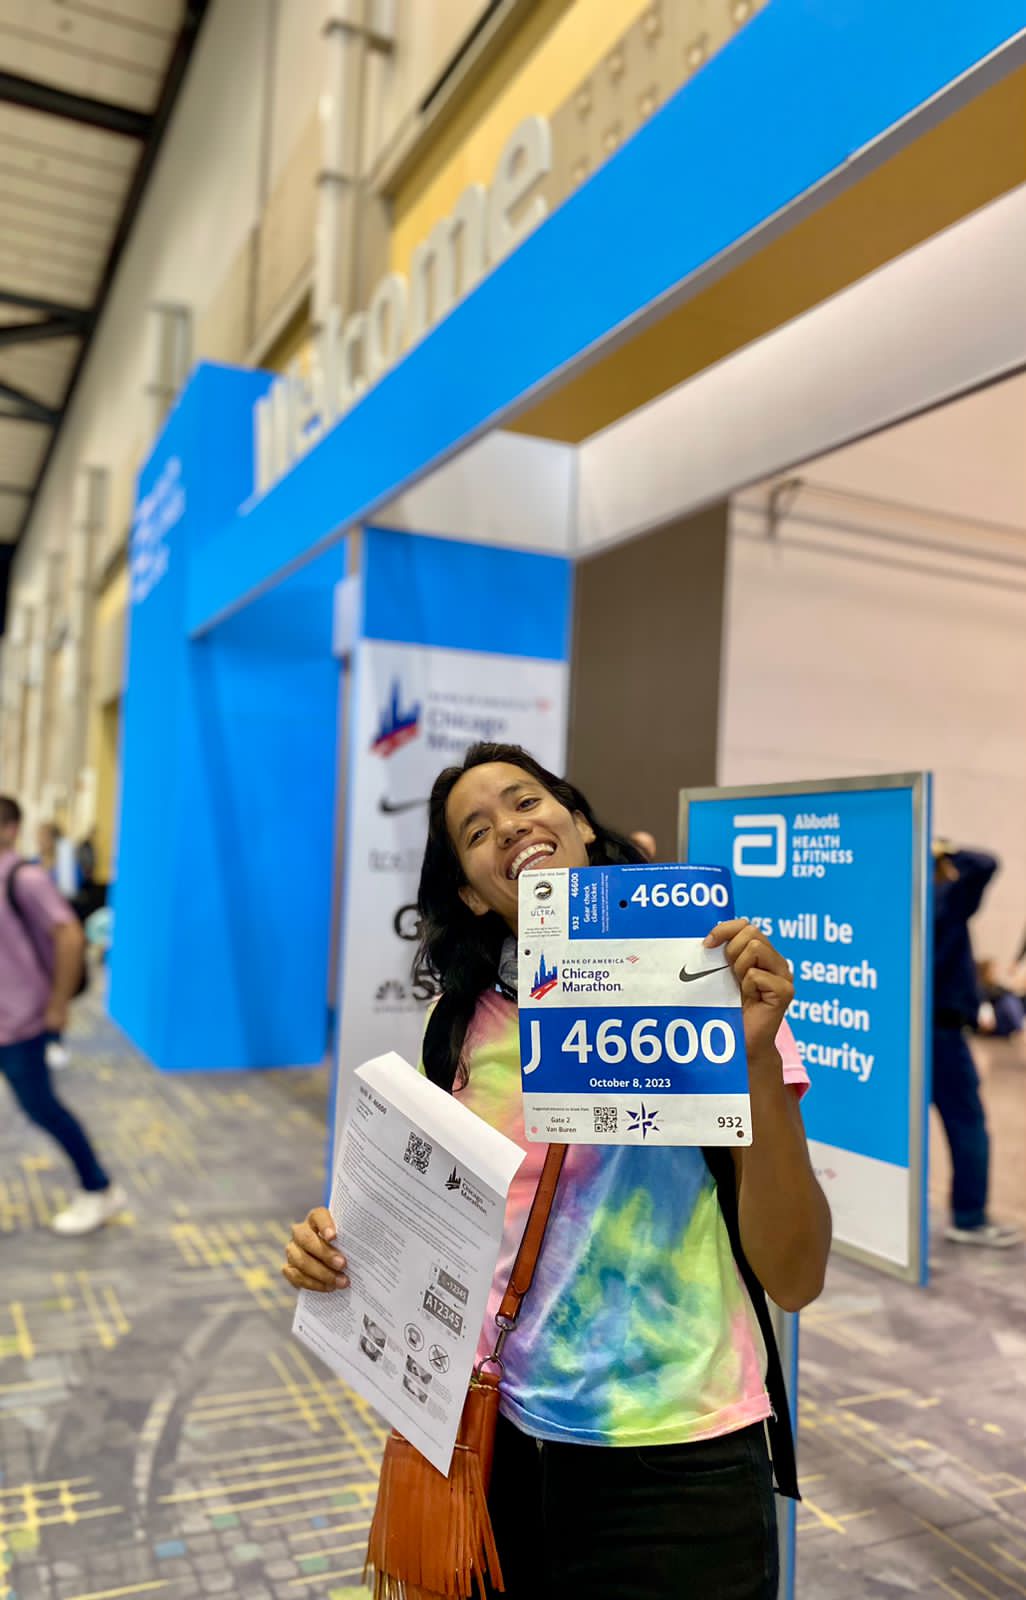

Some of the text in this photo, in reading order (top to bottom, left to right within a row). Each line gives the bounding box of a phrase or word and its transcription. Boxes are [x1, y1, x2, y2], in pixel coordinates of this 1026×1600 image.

[793, 813, 840, 829] Abbott
[792, 835, 840, 849] HEALTH
[792, 849, 854, 864] & FITNESS
[792, 864, 826, 879] EXPO
[571, 873, 579, 897] 46600
[631, 882, 729, 908] 46600
[583, 885, 591, 923] Gear check
[530, 909, 555, 917] ULTRA
[572, 916, 580, 930] 932
[778, 913, 818, 940] will
[824, 914, 853, 944] be
[562, 967, 610, 981] Chicago
[800, 960, 878, 990] search
[783, 998, 870, 1032] cretion
[523, 1019, 736, 1075] J 46600
[796, 1039, 874, 1082] ecurity
[589, 1078, 672, 1089] October 8, 2023
[551, 1116, 571, 1124] Gate 2
[717, 1116, 744, 1129] 932
